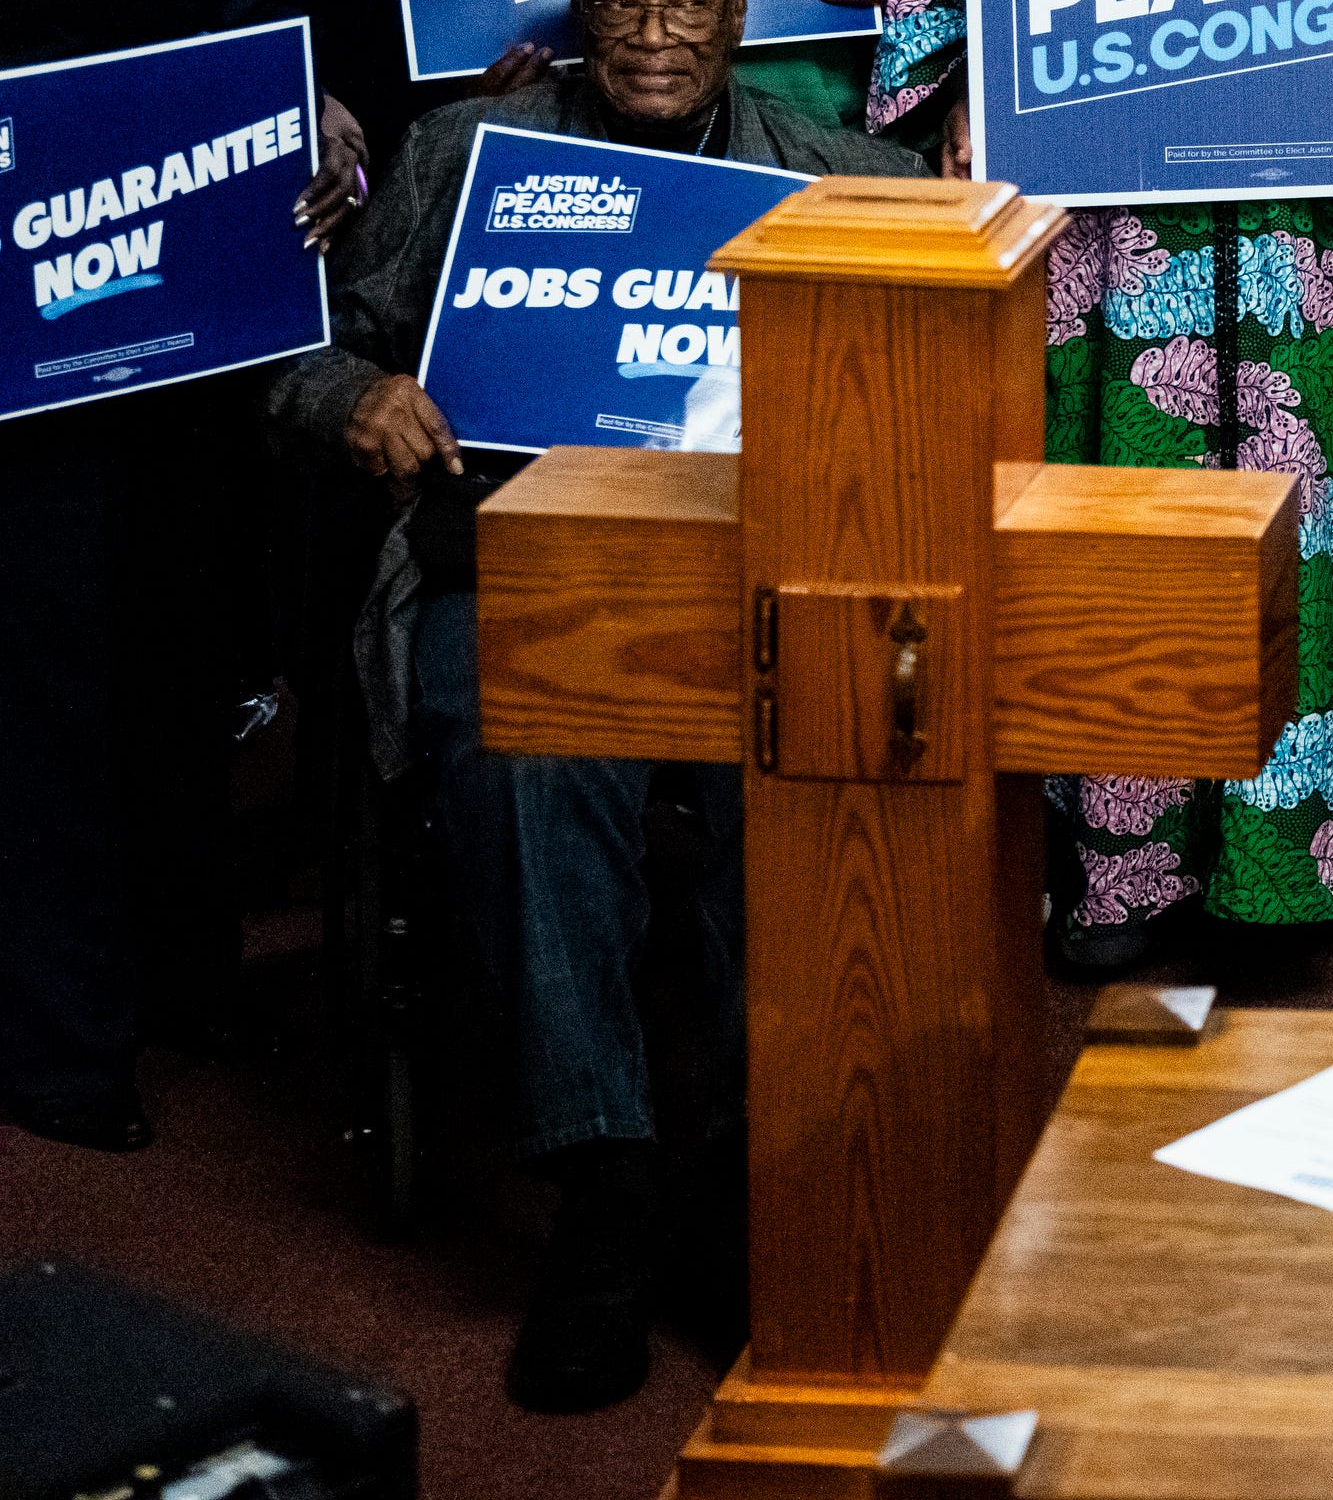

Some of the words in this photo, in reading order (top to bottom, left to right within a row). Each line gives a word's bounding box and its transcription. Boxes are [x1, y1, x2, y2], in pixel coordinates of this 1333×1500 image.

[1229, 148, 1273, 156] Committee
[1308, 145, 1331, 154] Justin
[13, 107, 302, 250] GUARANTEE
[514, 175, 598, 193] JUSTIN
[494, 194, 636, 214] PEARSON
[34, 221, 164, 307] NOW
[453, 268, 601, 308] JOBS
